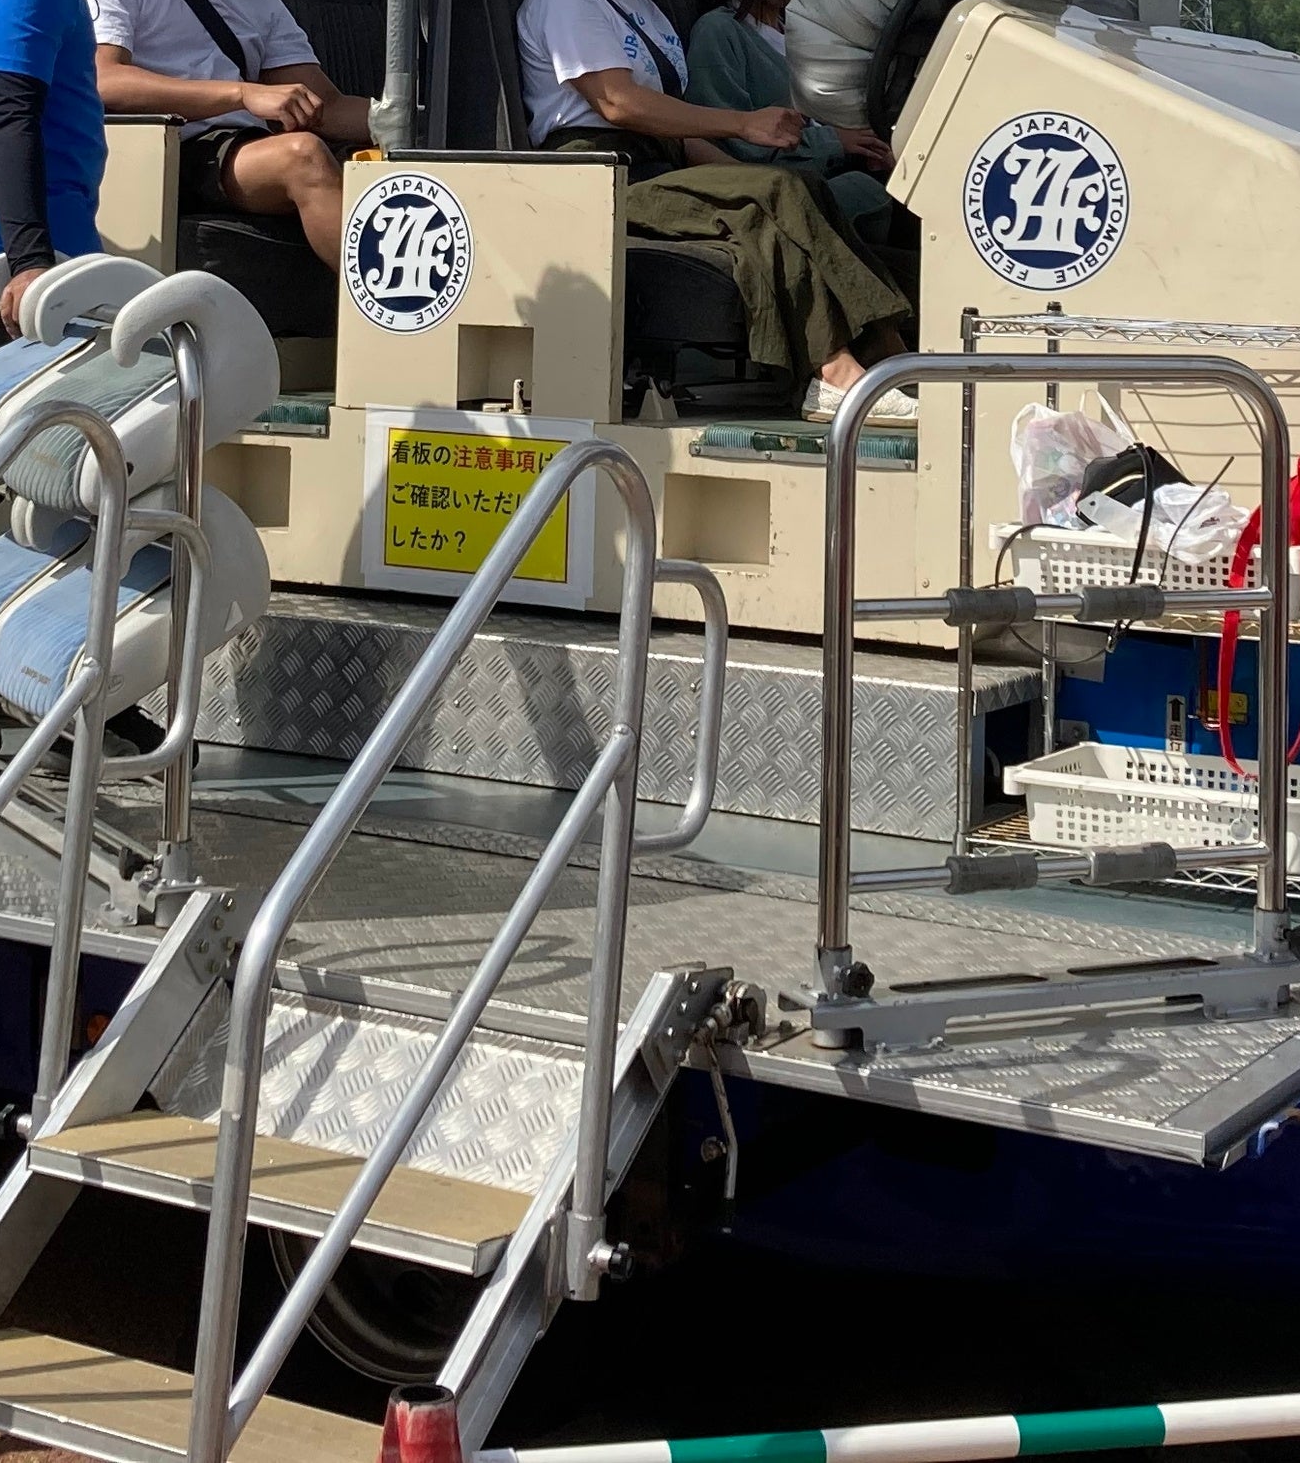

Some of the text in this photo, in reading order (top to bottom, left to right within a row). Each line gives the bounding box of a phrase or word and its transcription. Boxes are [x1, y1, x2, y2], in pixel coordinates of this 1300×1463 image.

[1012, 117, 1090, 142] JAPAN
[379, 179, 439, 199] JAPAN
[969, 156, 1029, 282] FEDERATION
[1053, 163, 1124, 284] AUTOMOBILE
[348, 217, 395, 325] FEDERATION
[415, 216, 466, 325] AUTOMOBILE
